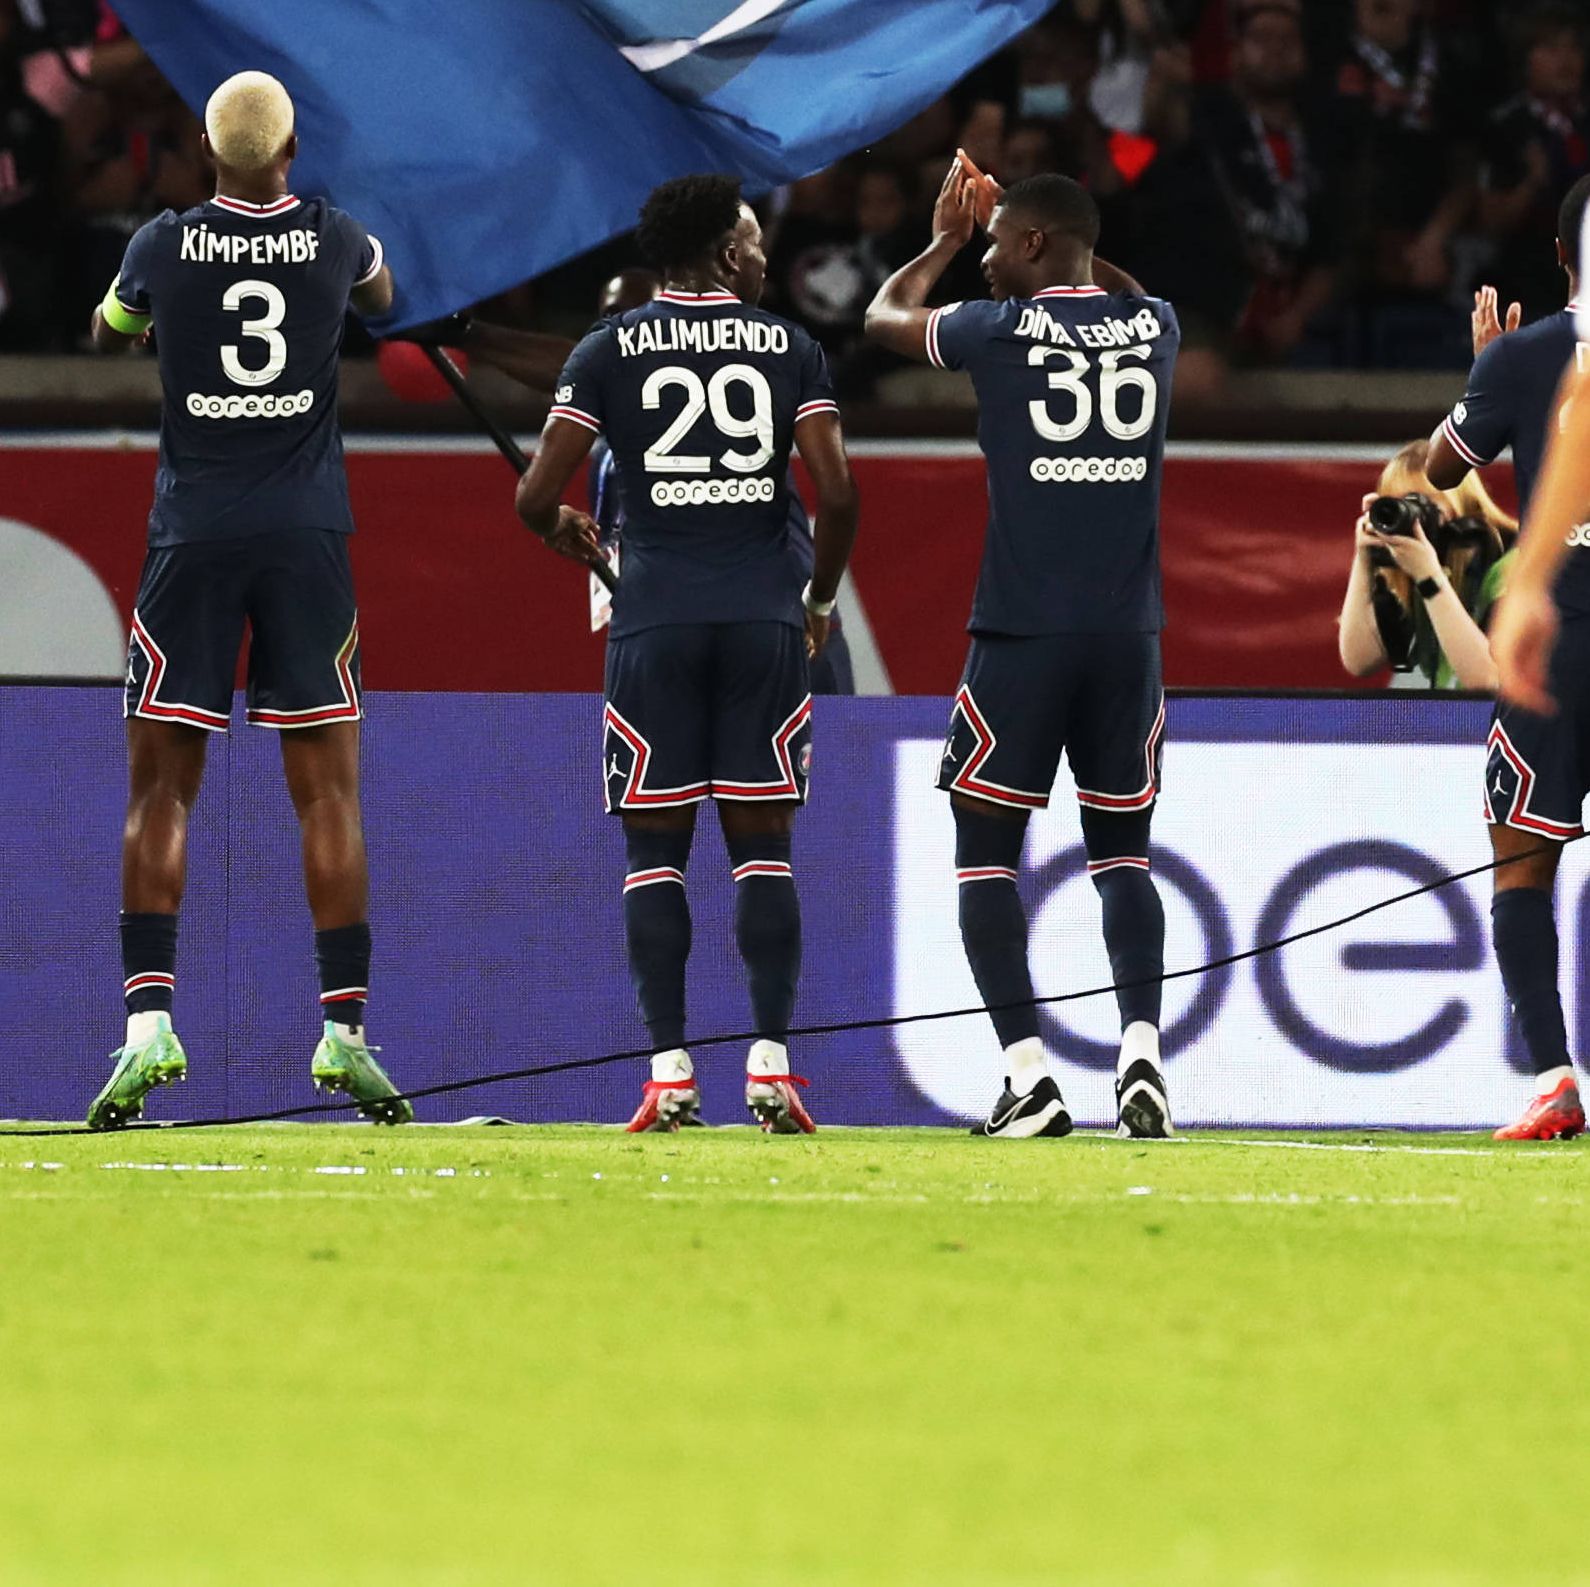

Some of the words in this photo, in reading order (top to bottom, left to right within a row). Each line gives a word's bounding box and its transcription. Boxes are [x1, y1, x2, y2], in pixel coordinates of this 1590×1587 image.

[220, 279, 287, 387] 3
[618, 317, 789, 358] KALIMUENDO
[188, 391, 312, 417] ooredoo
[1027, 343, 1157, 442] 36
[641, 363, 775, 473] 29
[1031, 457, 1146, 482] ooredoo
[652, 478, 774, 505] ooredoo
